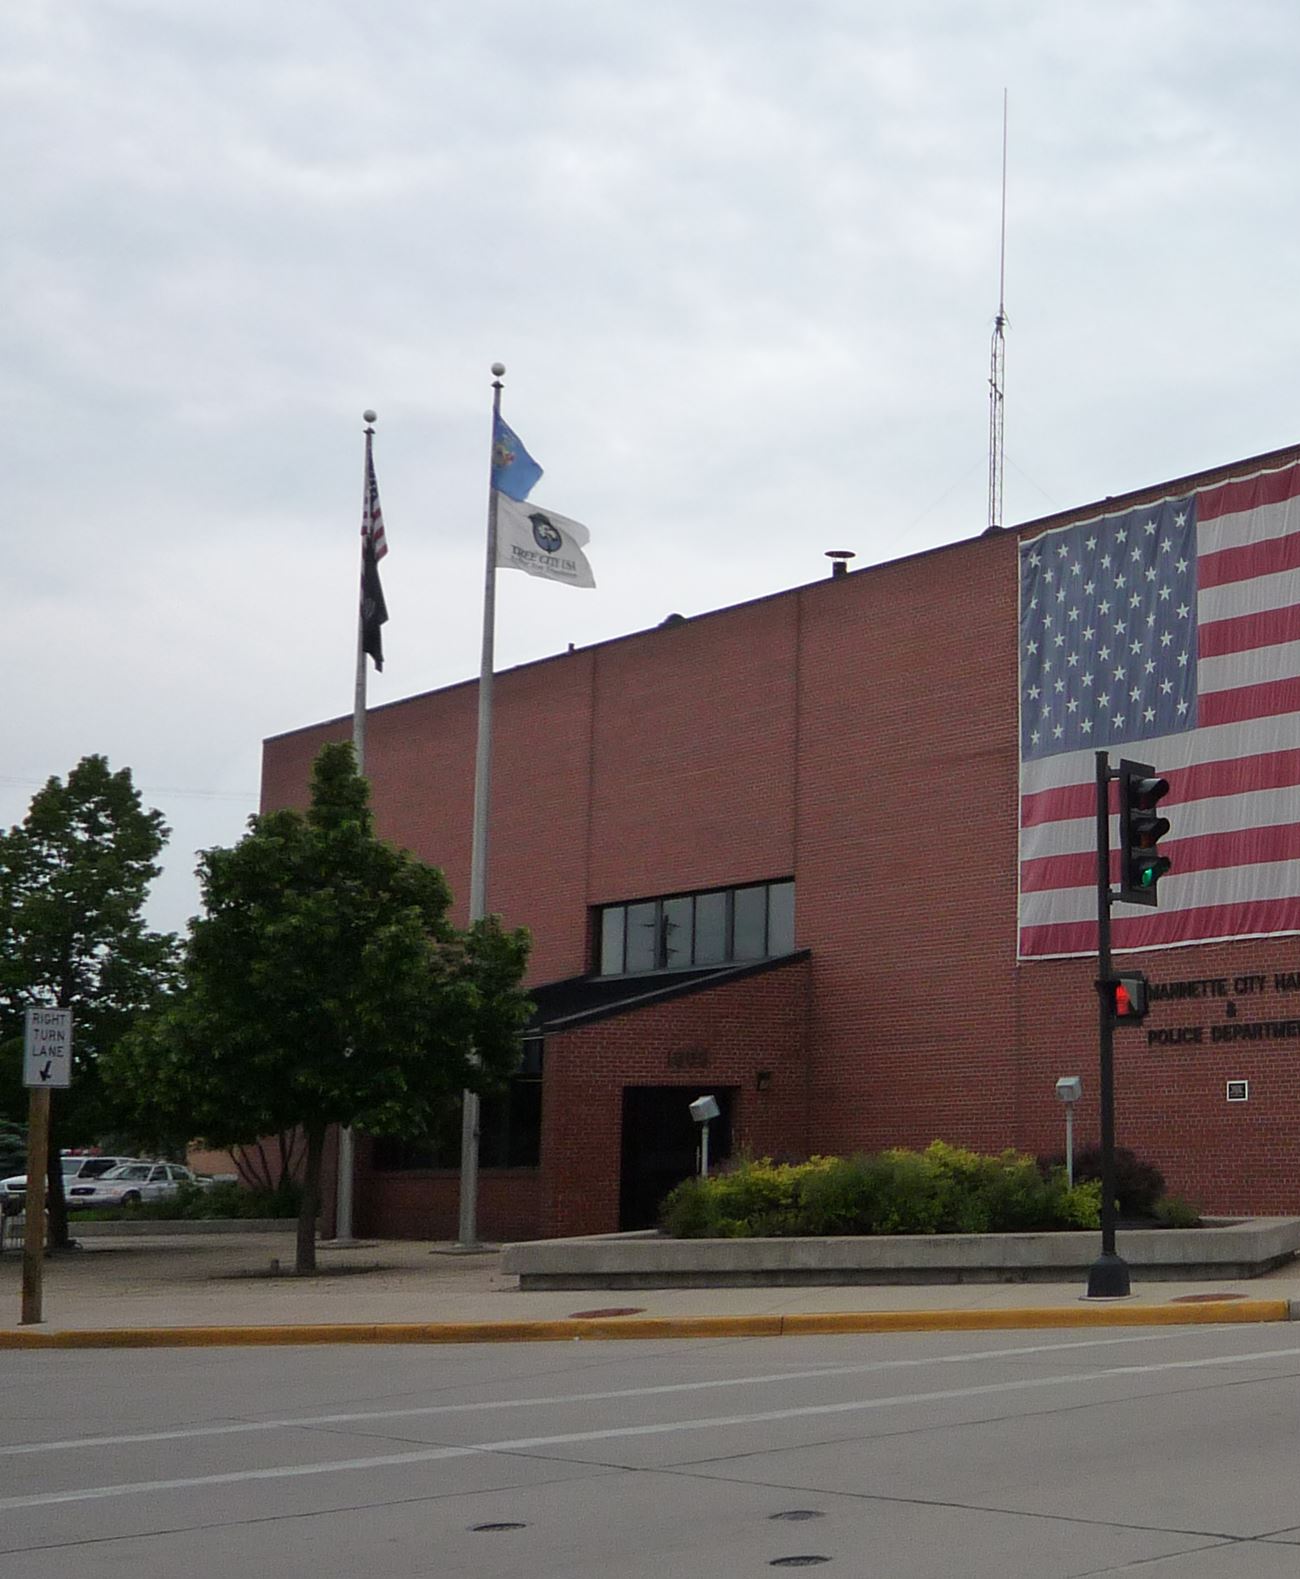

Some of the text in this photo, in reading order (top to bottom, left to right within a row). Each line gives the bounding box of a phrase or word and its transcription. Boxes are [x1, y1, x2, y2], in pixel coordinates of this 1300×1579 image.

[1234, 974, 1267, 994] CITY
[32, 1012, 66, 1025] RIGHT
[33, 1029, 65, 1041] TURN
[1148, 1027, 1203, 1046] POLICE
[32, 1045, 65, 1058] LANE
